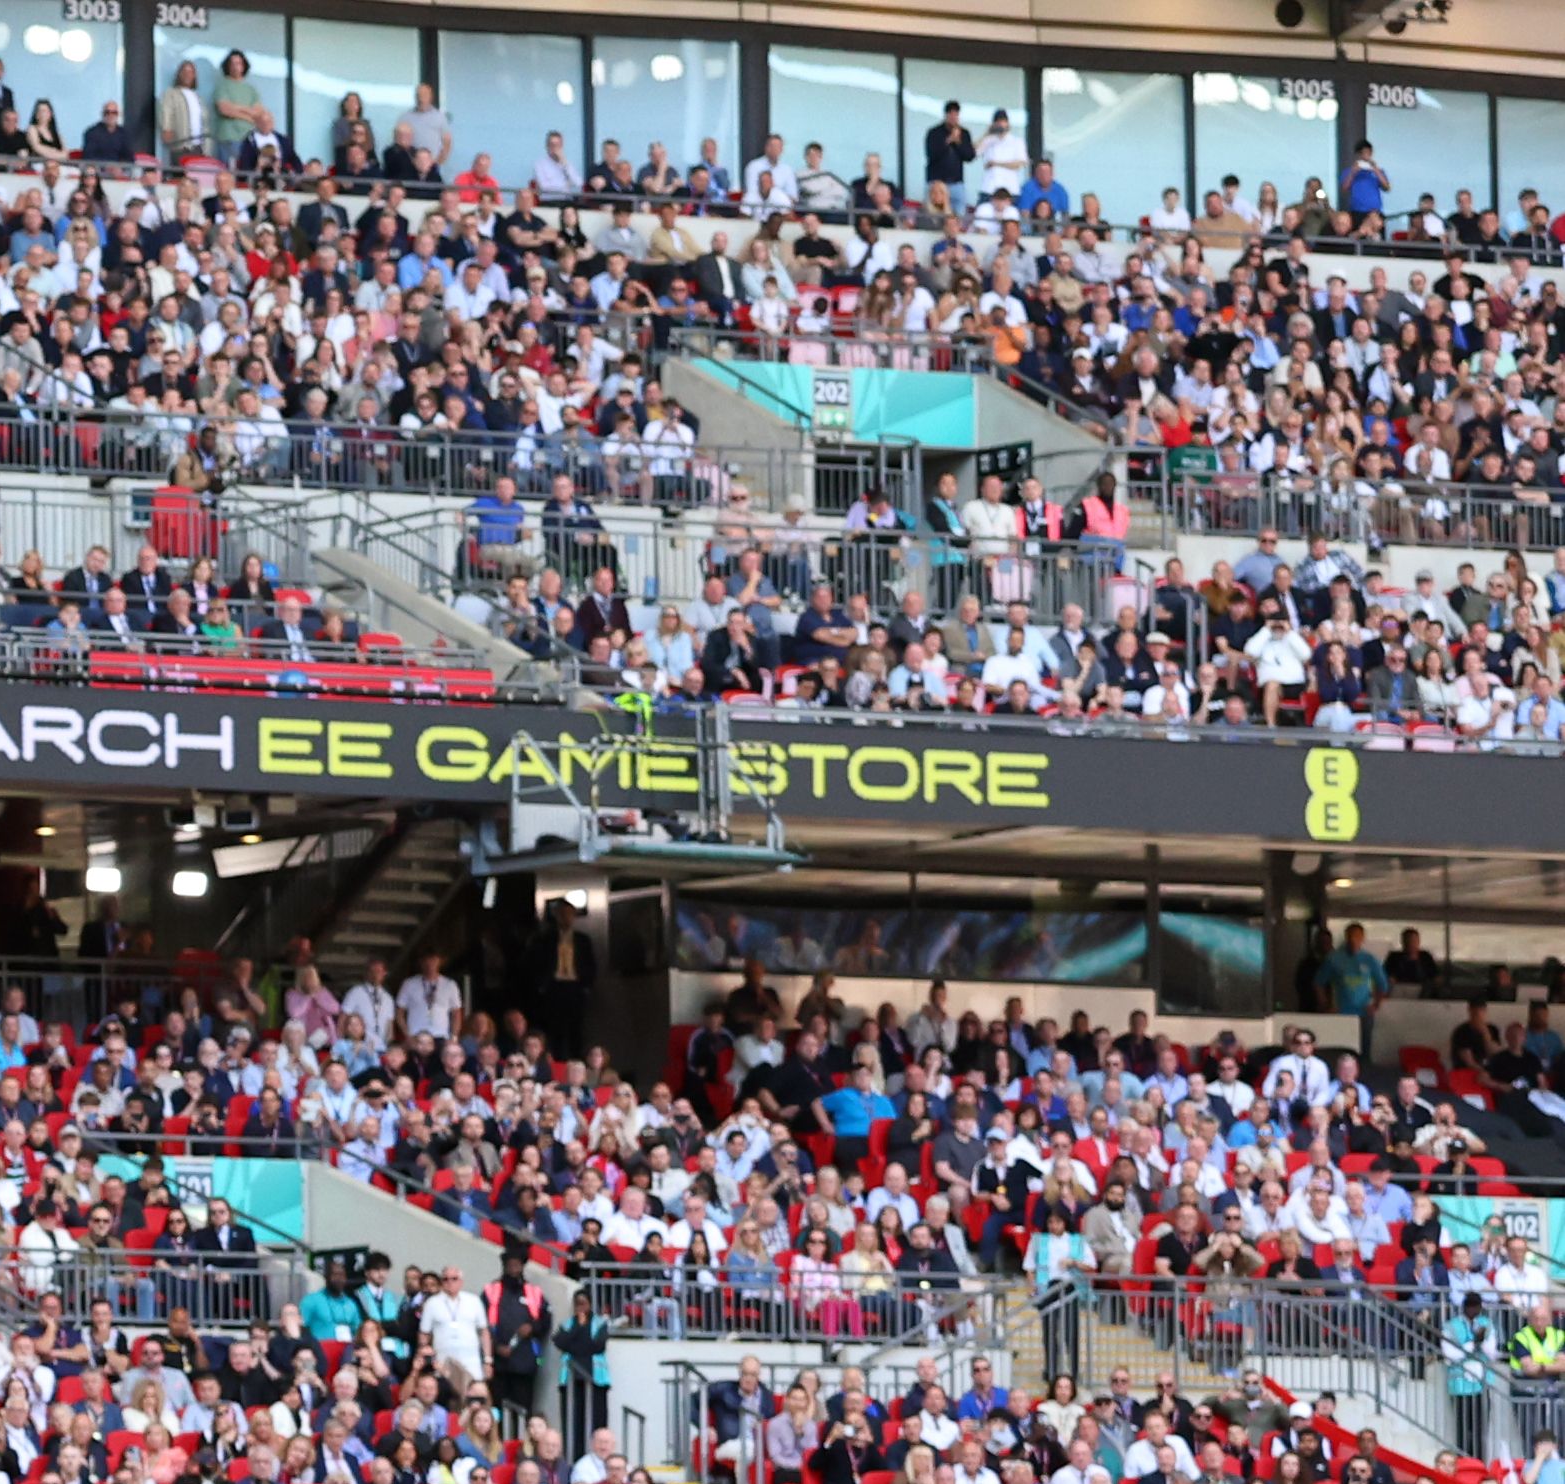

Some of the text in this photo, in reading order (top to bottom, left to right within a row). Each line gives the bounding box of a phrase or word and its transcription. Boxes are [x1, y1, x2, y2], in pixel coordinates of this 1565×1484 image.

[65, 0, 120, 22] 3003
[156, 3, 206, 28] 3004
[1284, 77, 1334, 100] 3005
[1368, 83, 1416, 108] 3006
[814, 381, 850, 403] 202
[258, 717, 394, 779] EE
[416, 726, 699, 795] GAME
[729, 743, 1050, 808] STORE
[1504, 1214, 1539, 1239] 102
